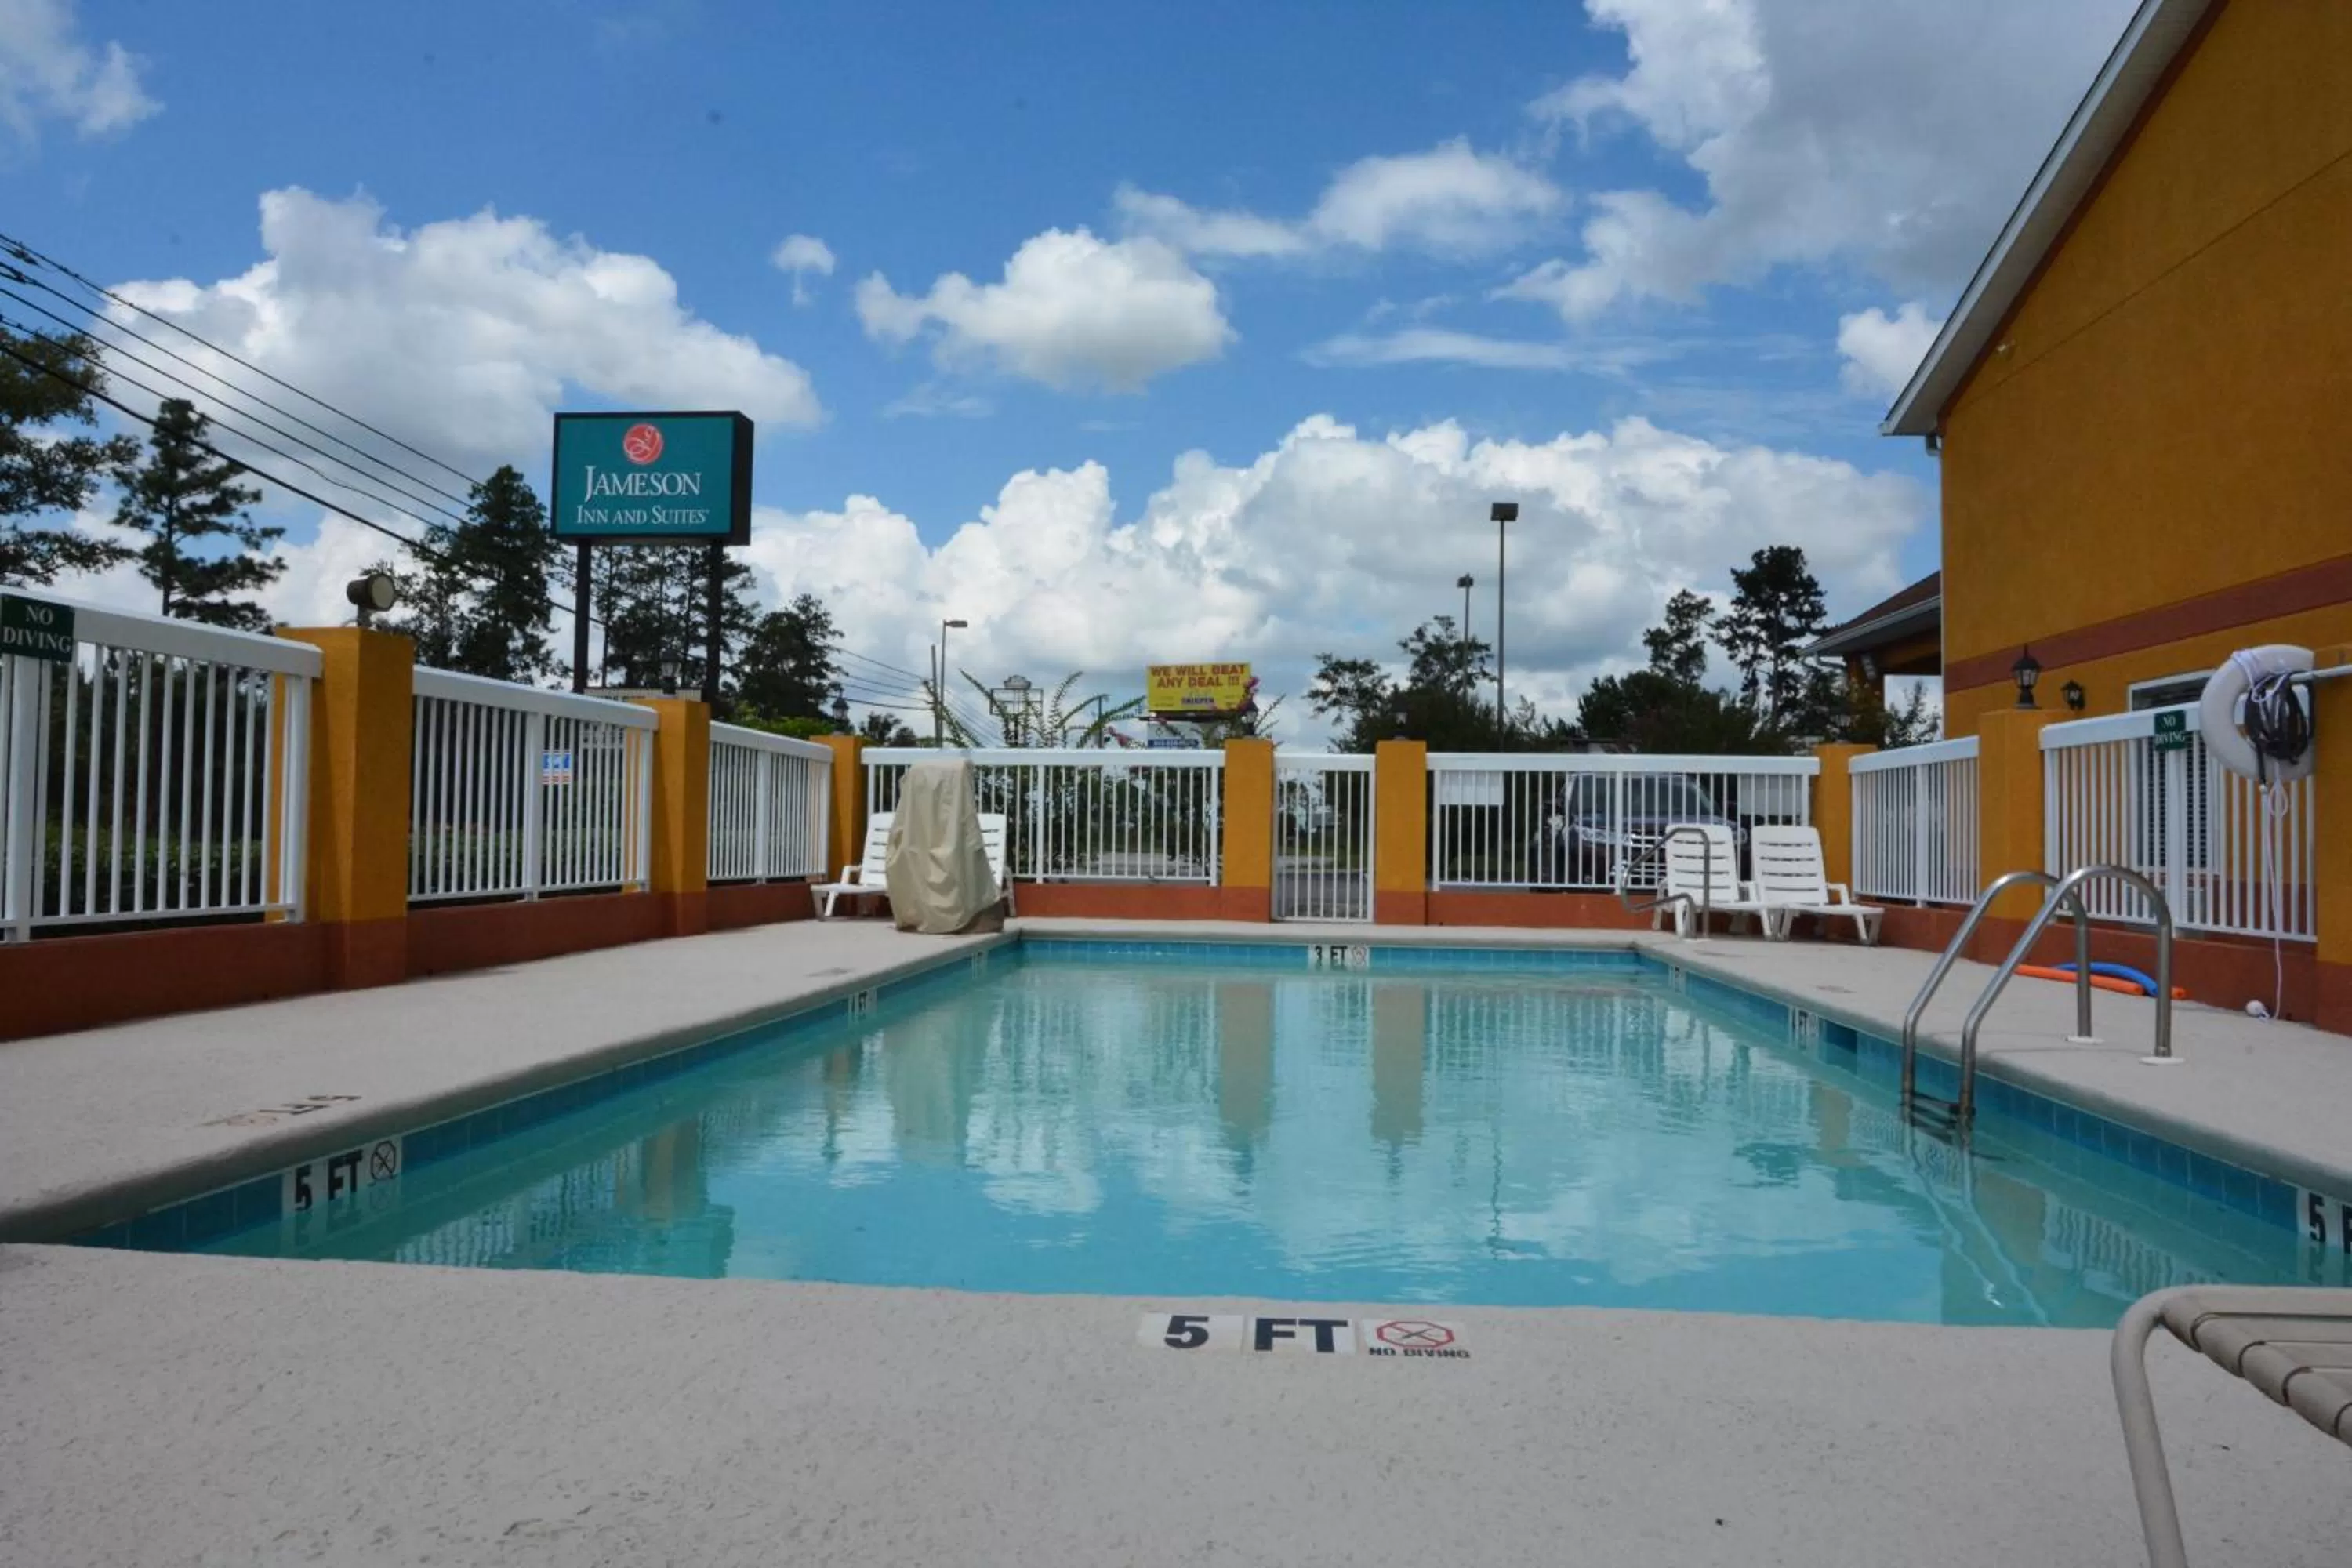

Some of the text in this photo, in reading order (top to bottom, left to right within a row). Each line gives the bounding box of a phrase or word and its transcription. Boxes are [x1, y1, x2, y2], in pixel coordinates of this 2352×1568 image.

[585, 465, 702, 503] JAMESON
[576, 505, 706, 524] INN AND SUITES
[25, 604, 54, 626] NO
[3, 626, 71, 653] DIVING
[1151, 666, 1171, 677] WE
[1175, 665, 1207, 676] WILL
[1157, 677, 1183, 688] ANY
[1188, 677, 1223, 688] DEAL
[2162, 715, 2176, 728] NO
[1330, 946, 1348, 961] FT
[295, 1149, 362, 1211] 5 FT
[2309, 1191, 2326, 1243] 5
[1164, 1315, 1348, 1352] 5 FT
[1369, 1347, 1471, 1358] NO DIVING
